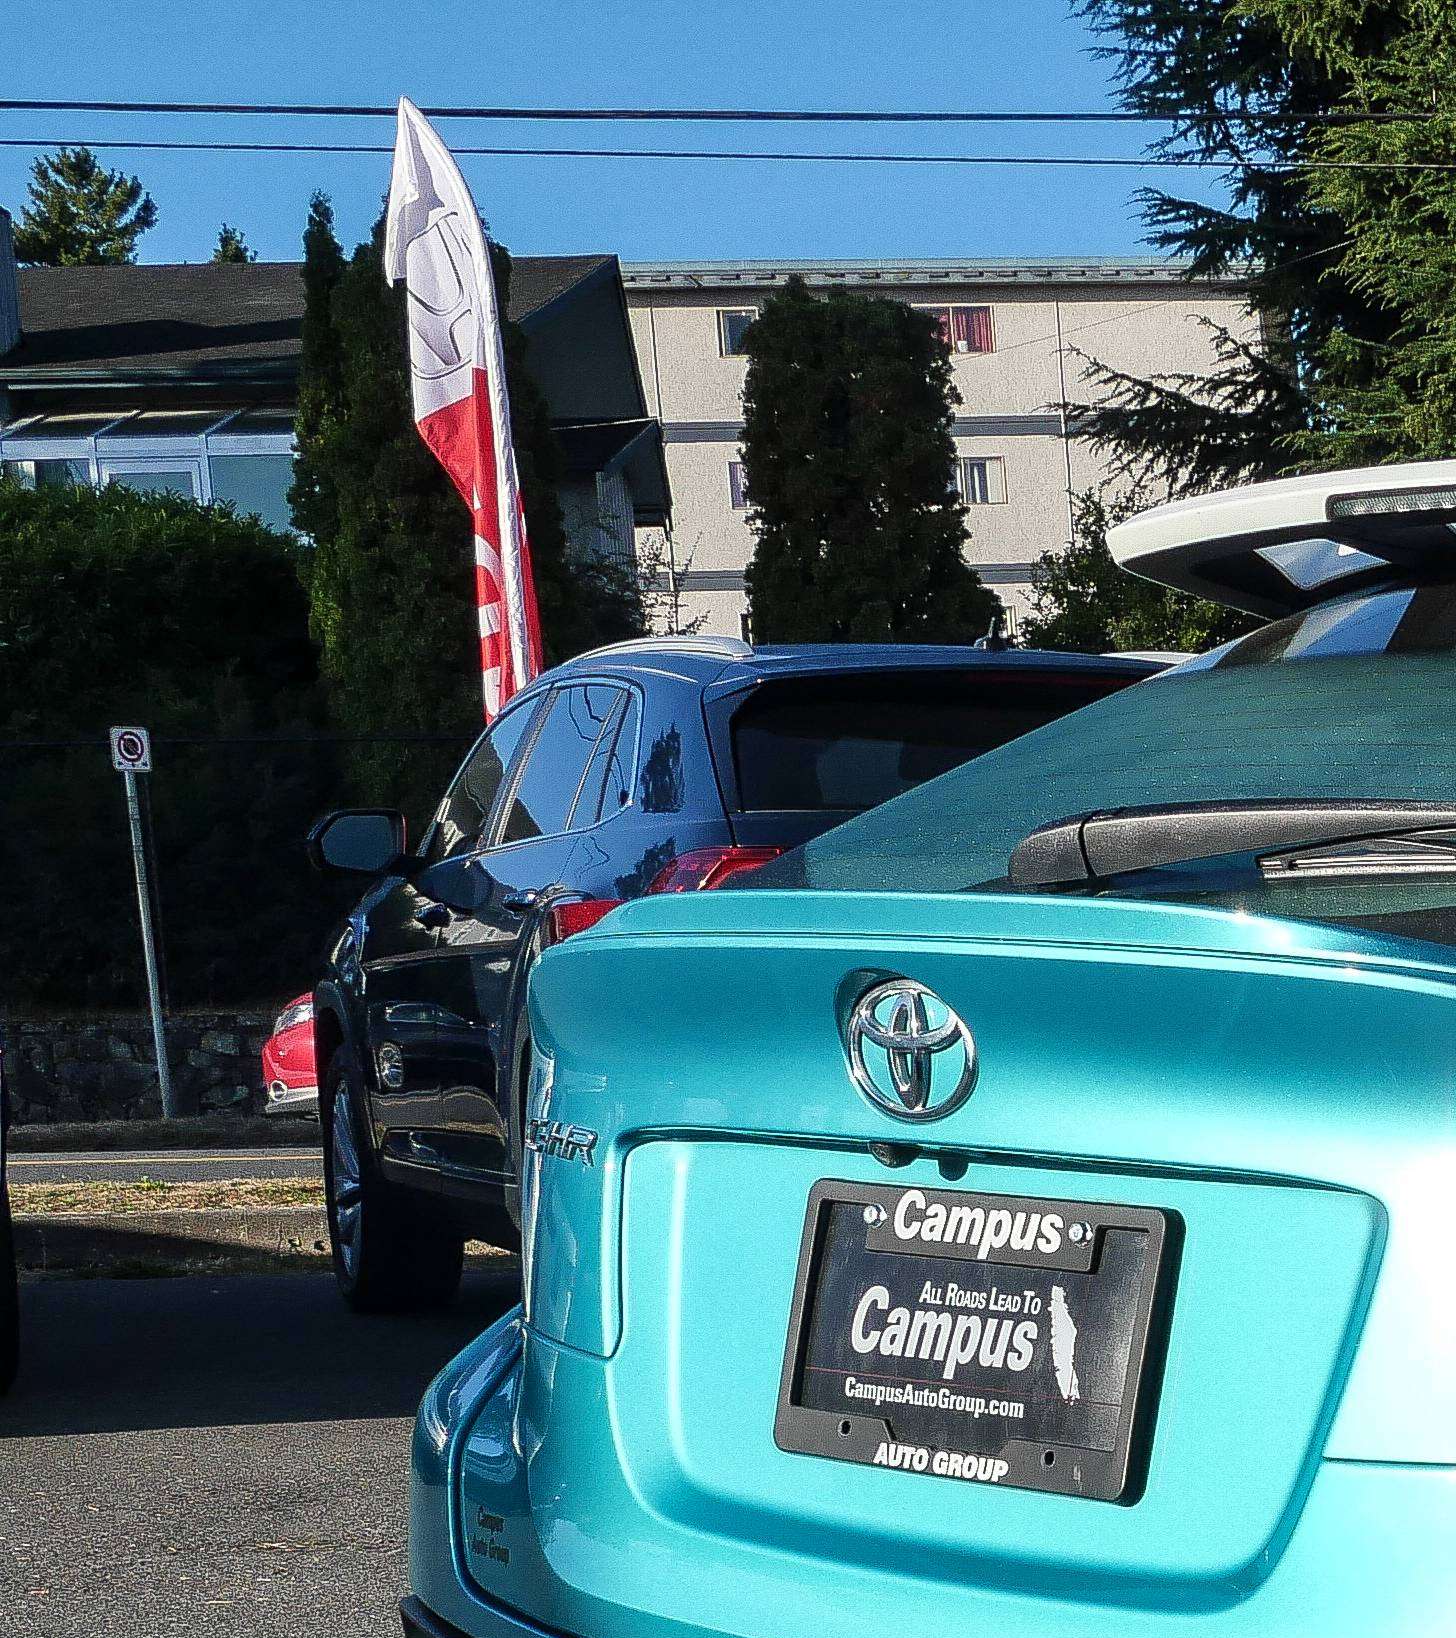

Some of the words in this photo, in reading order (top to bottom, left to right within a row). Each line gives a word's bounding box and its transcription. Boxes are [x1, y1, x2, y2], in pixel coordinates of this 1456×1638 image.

[893, 1189, 1064, 1259] Campus
[851, 1285, 1038, 1379] Campus
[845, 1376, 1024, 1419] CampusAutoGroup.com
[873, 1441, 928, 1472] AUTO
[932, 1454, 1009, 1483] GROUP
